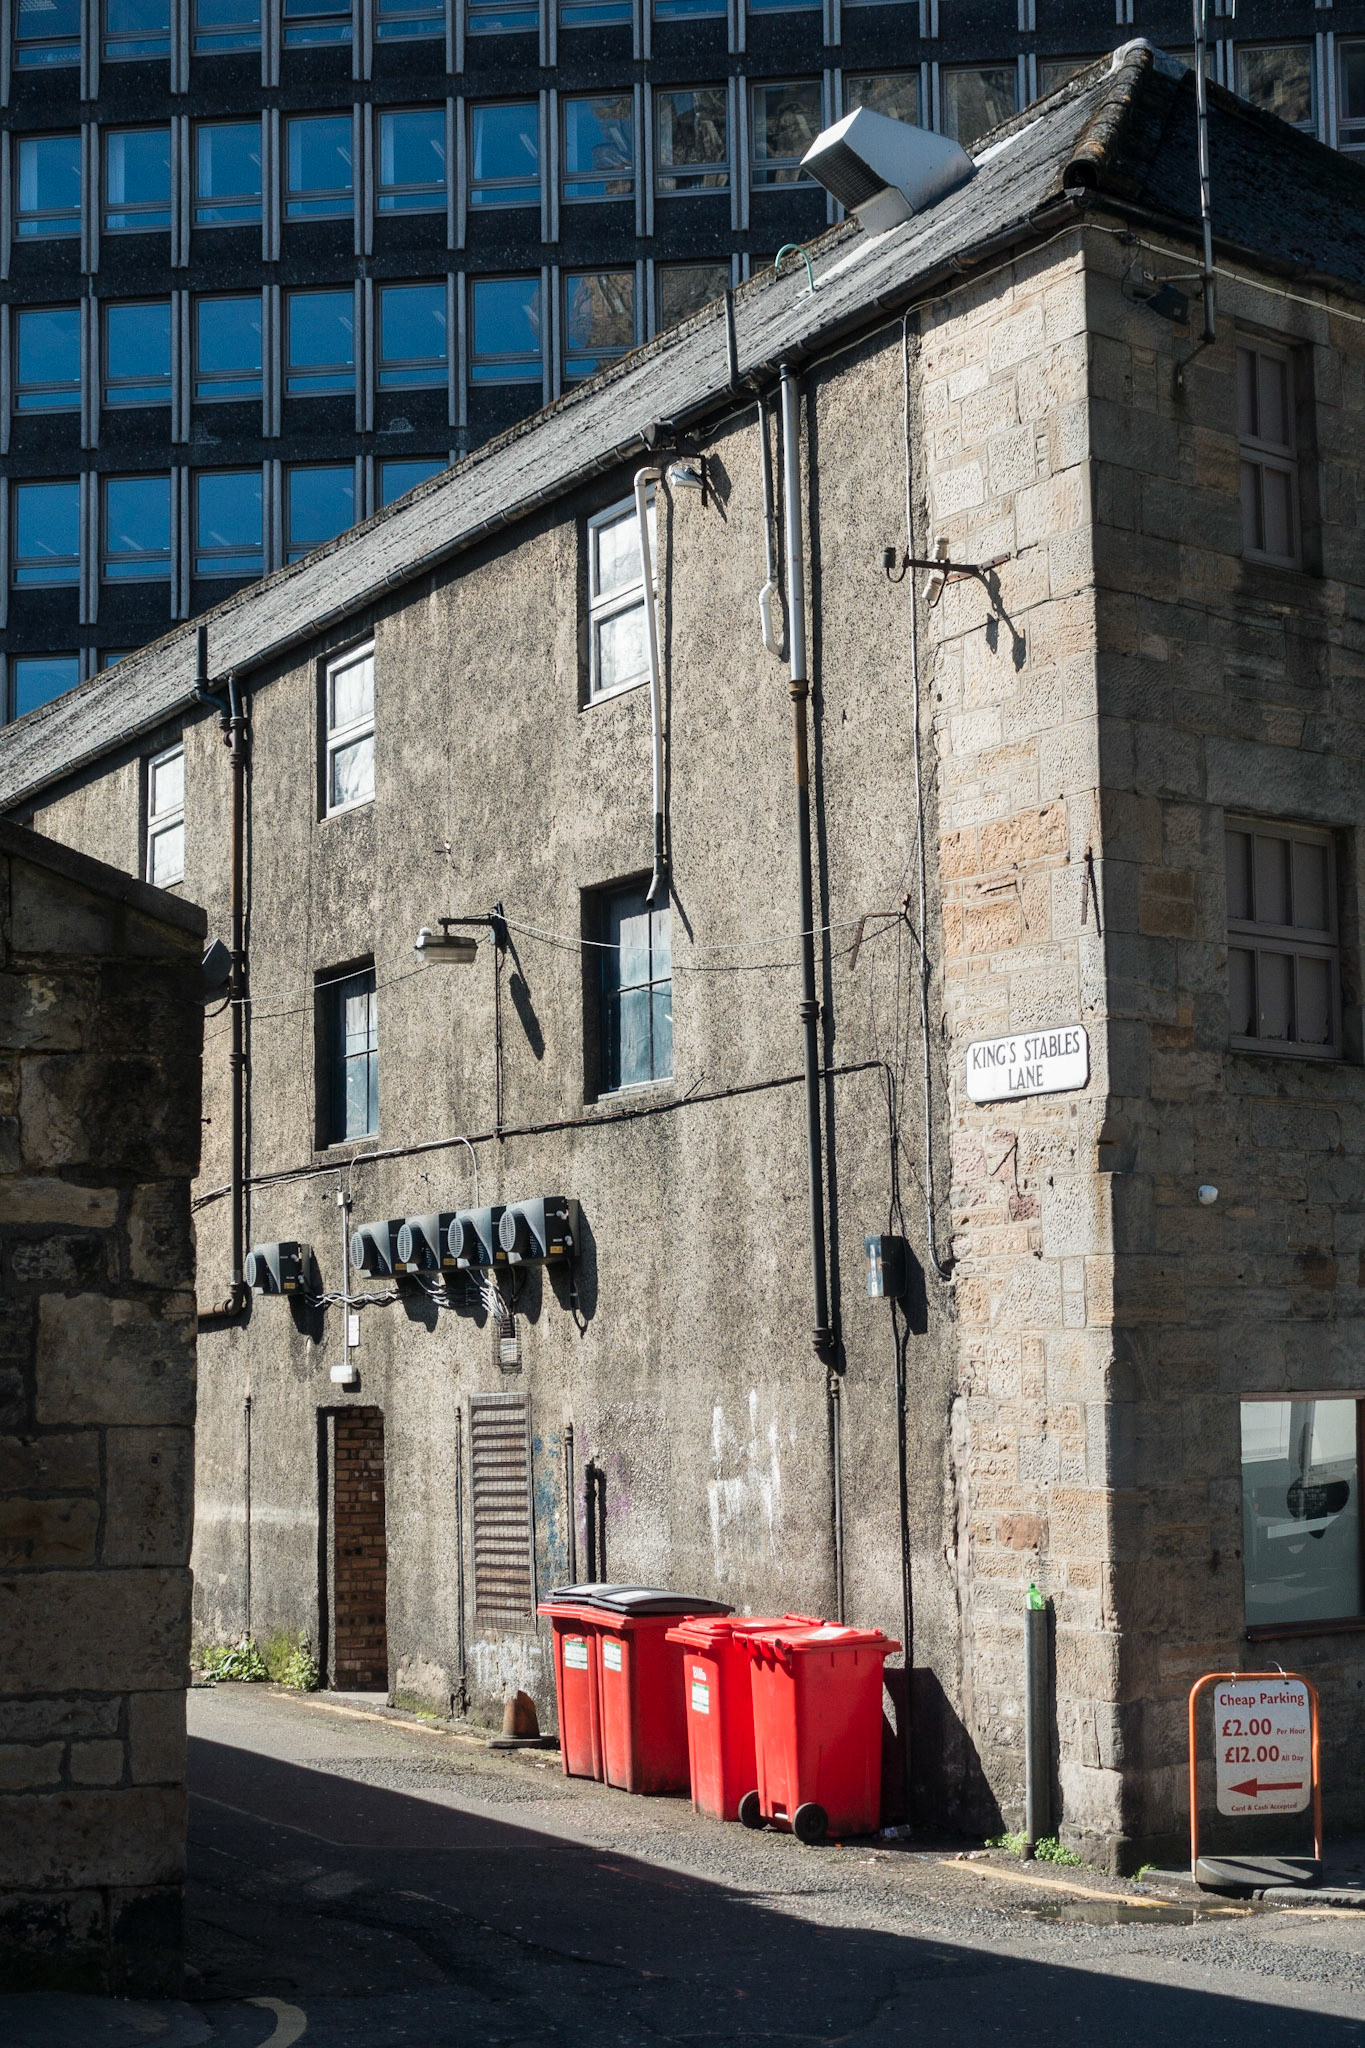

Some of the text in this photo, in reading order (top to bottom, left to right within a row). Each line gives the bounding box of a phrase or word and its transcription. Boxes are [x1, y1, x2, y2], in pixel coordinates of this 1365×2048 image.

[973, 1031, 1080, 1070] KING'S STABLES
[1008, 1064, 1044, 1091] LANE
[1220, 1692, 1305, 1708] Cheap Parking
[1222, 1718, 1272, 1736] £2.00
[1225, 1745, 1280, 1763] £12.00
